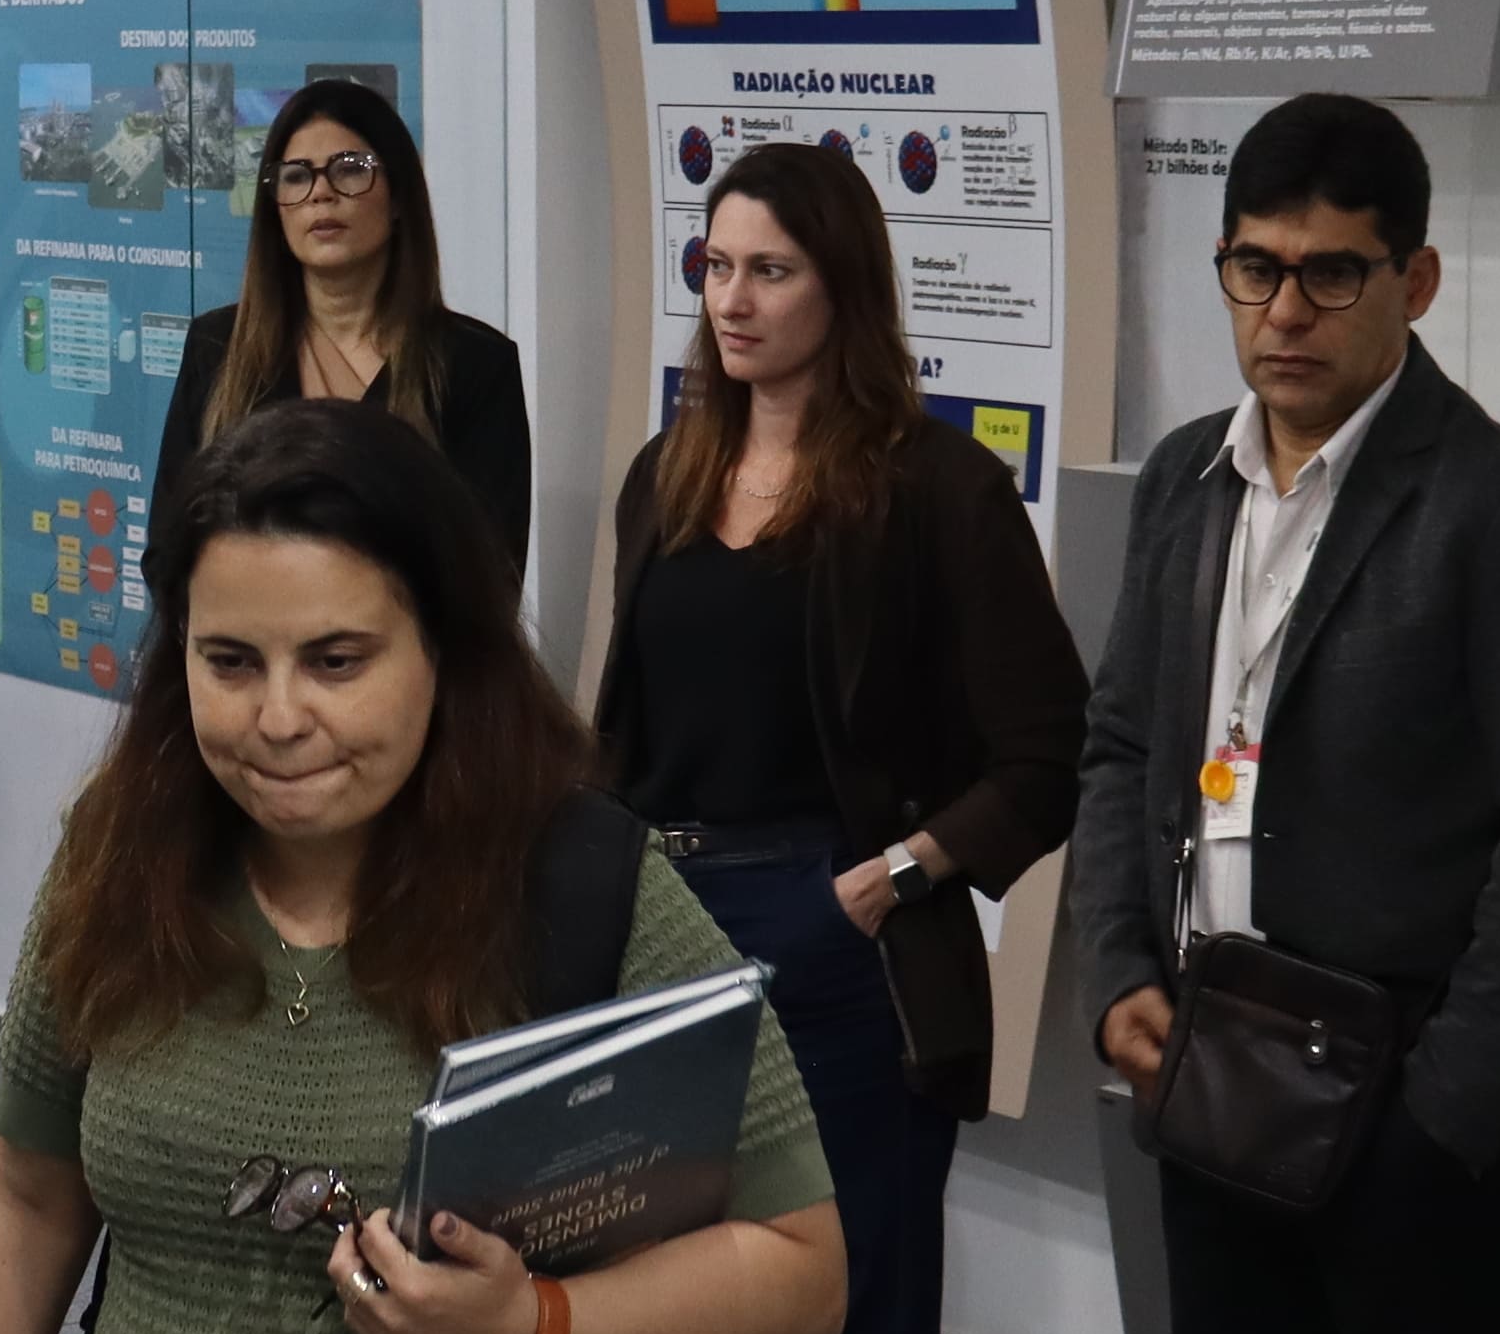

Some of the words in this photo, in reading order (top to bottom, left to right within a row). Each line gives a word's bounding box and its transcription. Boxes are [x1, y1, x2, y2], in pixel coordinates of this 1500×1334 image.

[119, 29, 166, 48] DESTINO
[194, 28, 256, 47] PRODUTOS
[732, 68, 835, 99] RADIAÇÃO
[839, 72, 935, 95] NUCLEAR
[1143, 138, 1188, 155] Método
[1190, 137, 1227, 155] Rb/Sr:
[1145, 160, 1164, 174] 2,7
[1166, 158, 1208, 175] bilhões
[1211, 159, 1227, 176] de
[15, 237, 32, 255] DA
[32, 239, 86, 259] REFINARIA
[87, 242, 116, 262] PARA
[116, 245, 126, 263] O
[51, 425, 68, 444] DA
[68, 428, 123, 452] REFINARIA
[35, 450, 62, 469] PARA
[62, 452, 142, 483] PETROQUÍMICA
[525, 1184, 627, 1236] STONES
[519, 1193, 646, 1258] DIMENSIO
